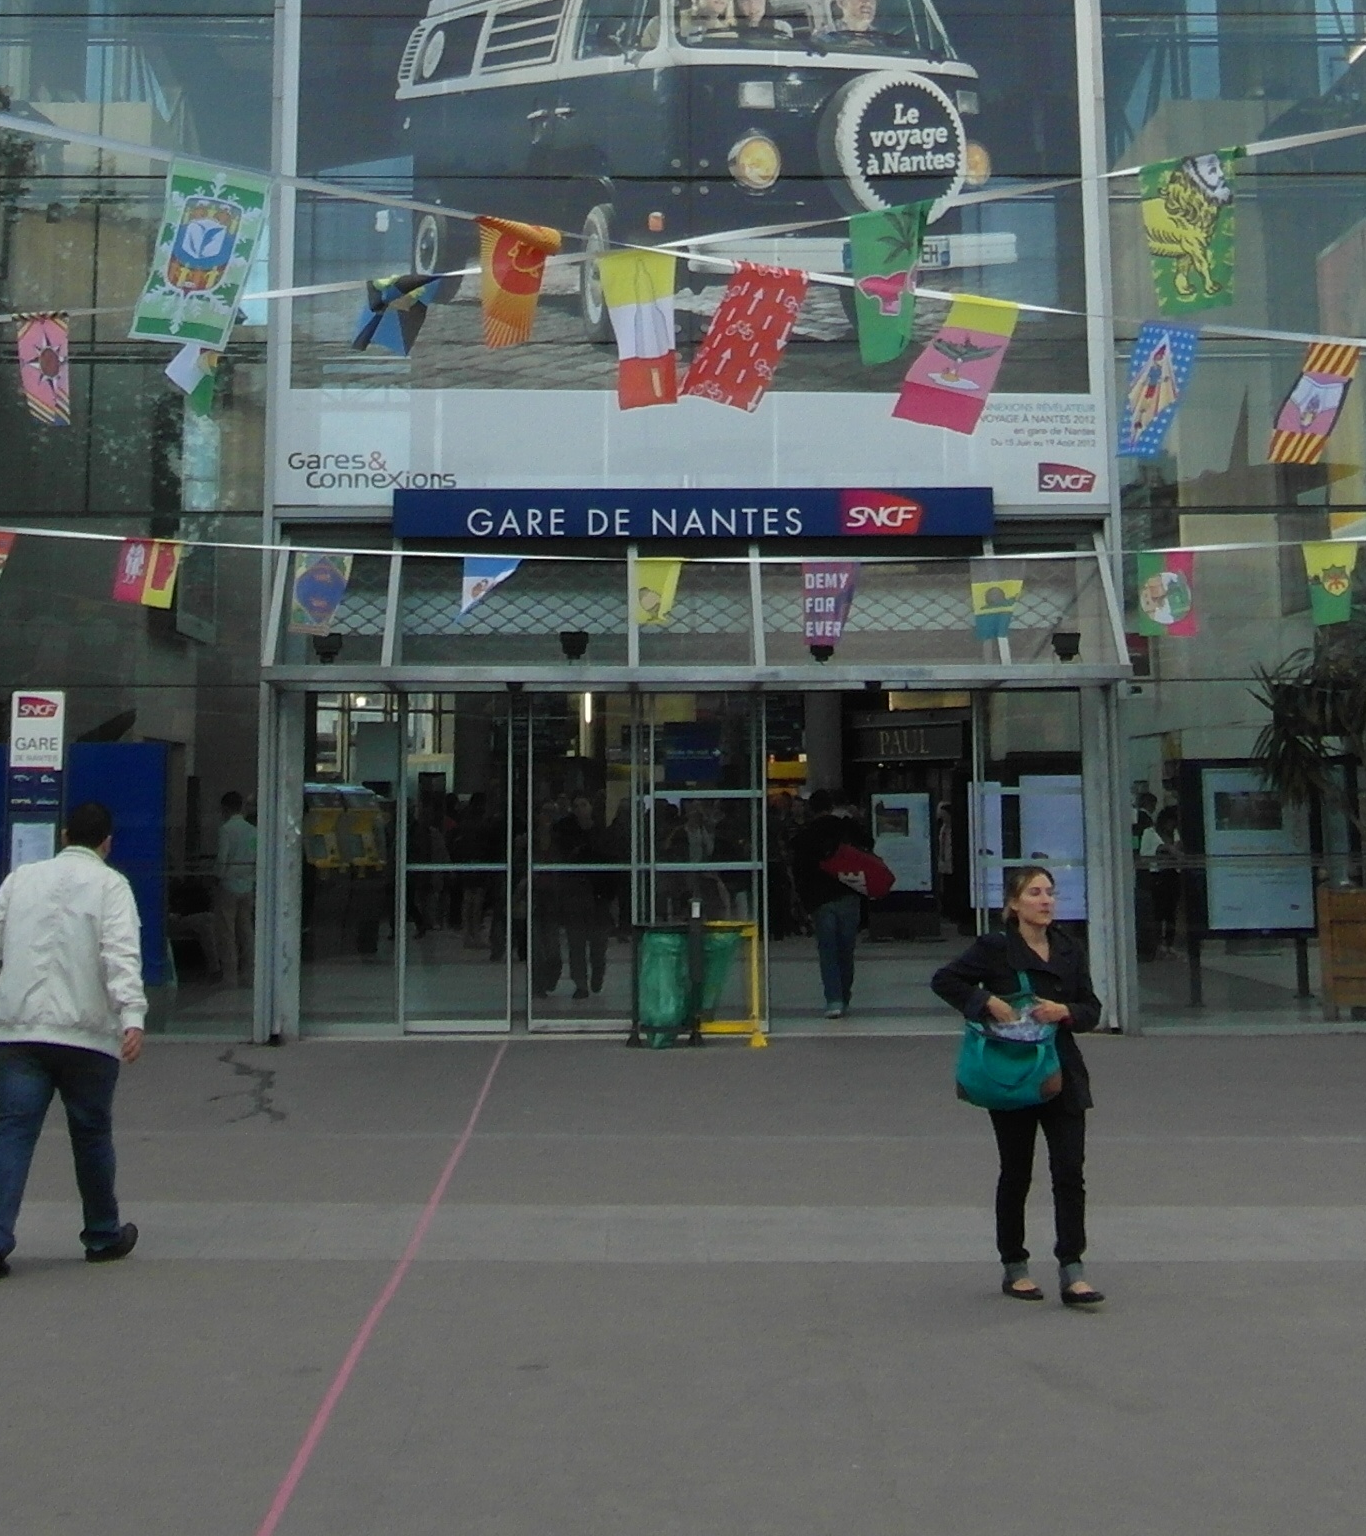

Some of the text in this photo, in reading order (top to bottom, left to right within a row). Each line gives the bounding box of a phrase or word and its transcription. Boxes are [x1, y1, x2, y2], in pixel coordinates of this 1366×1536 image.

[893, 102, 920, 125] Le
[869, 126, 949, 151] voyage
[865, 150, 956, 176] à Nantes
[1031, 414, 1071, 424] NANTES
[1073, 415, 1096, 424] 2012
[1064, 427, 1096, 436] Nantes
[1040, 474, 1093, 490] SNCF
[467, 508, 803, 536] GARE DE NANTES
[846, 505, 918, 528] SNCF
[804, 572, 849, 590] DEMY
[804, 596, 835, 613] FOR
[805, 621, 842, 637] EVER
[19, 704, 57, 716] SNCF
[15, 736, 59, 752] GARE
[878, 729, 931, 755] PAUL
